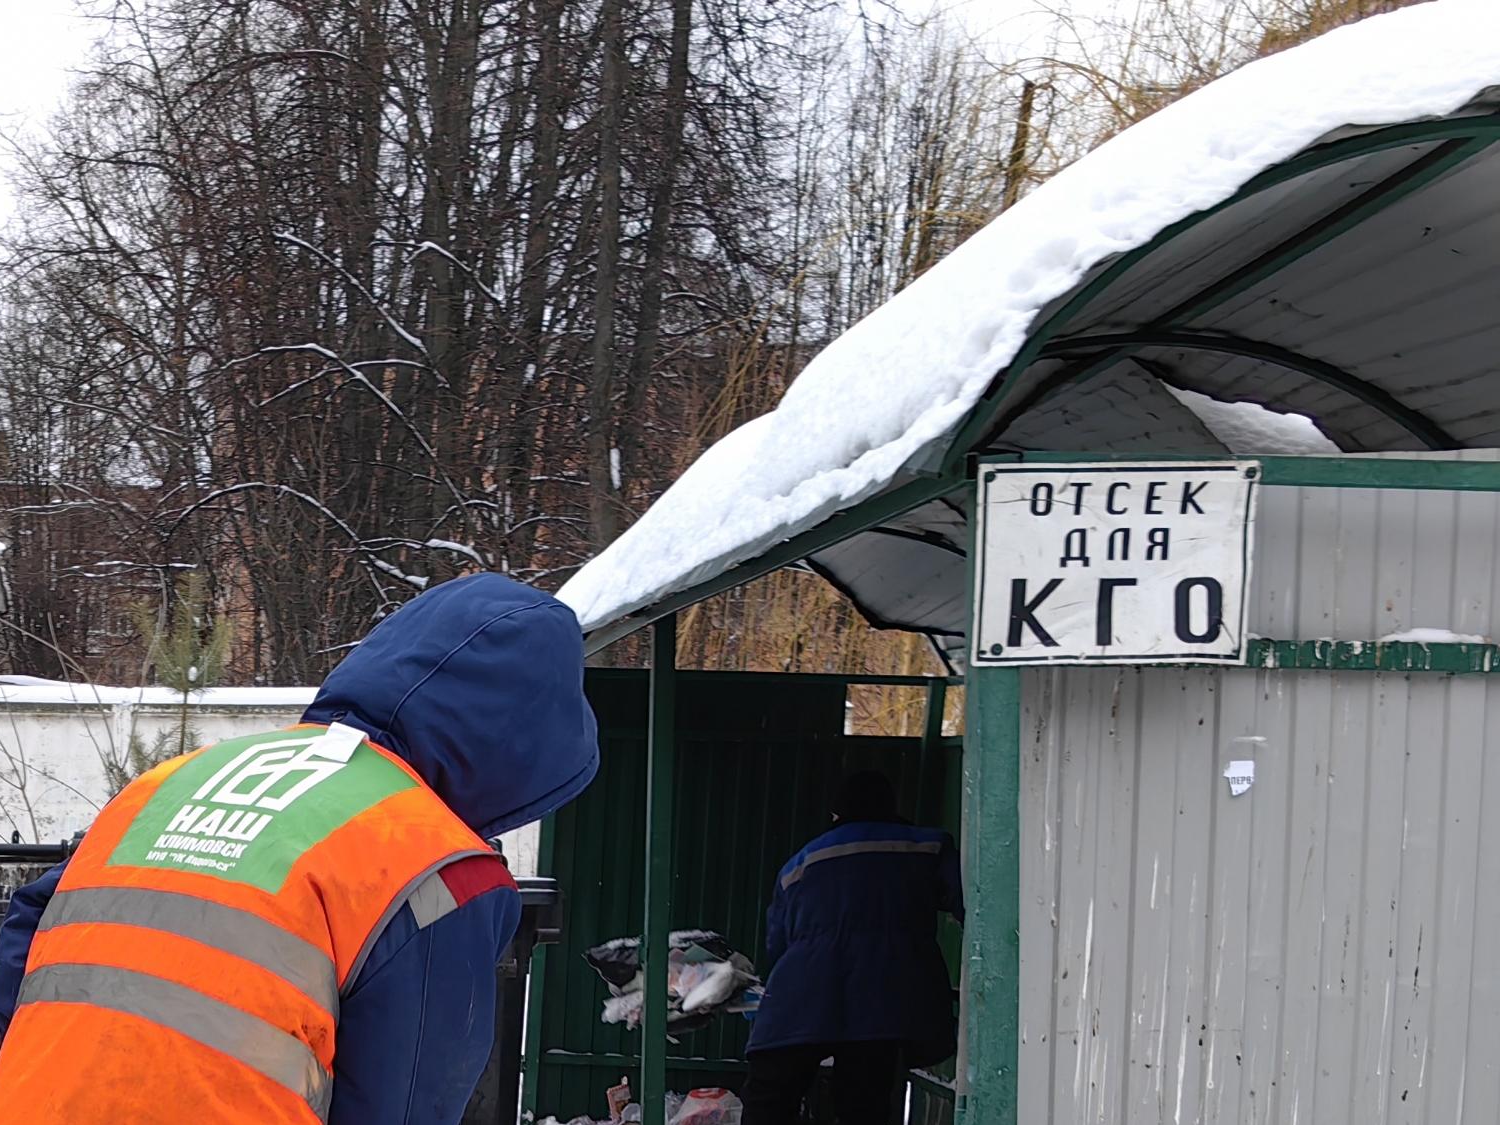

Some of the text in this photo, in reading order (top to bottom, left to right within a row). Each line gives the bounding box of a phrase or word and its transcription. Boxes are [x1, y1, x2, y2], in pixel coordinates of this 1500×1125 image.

[1030, 481, 1209, 516] ОТСЕК
[1060, 527, 1170, 567] ДЛЯ
[1007, 576, 1223, 647] КГО
[165, 804, 273, 841] НАШ
[153, 834, 248, 859] КЛИМОВСК
